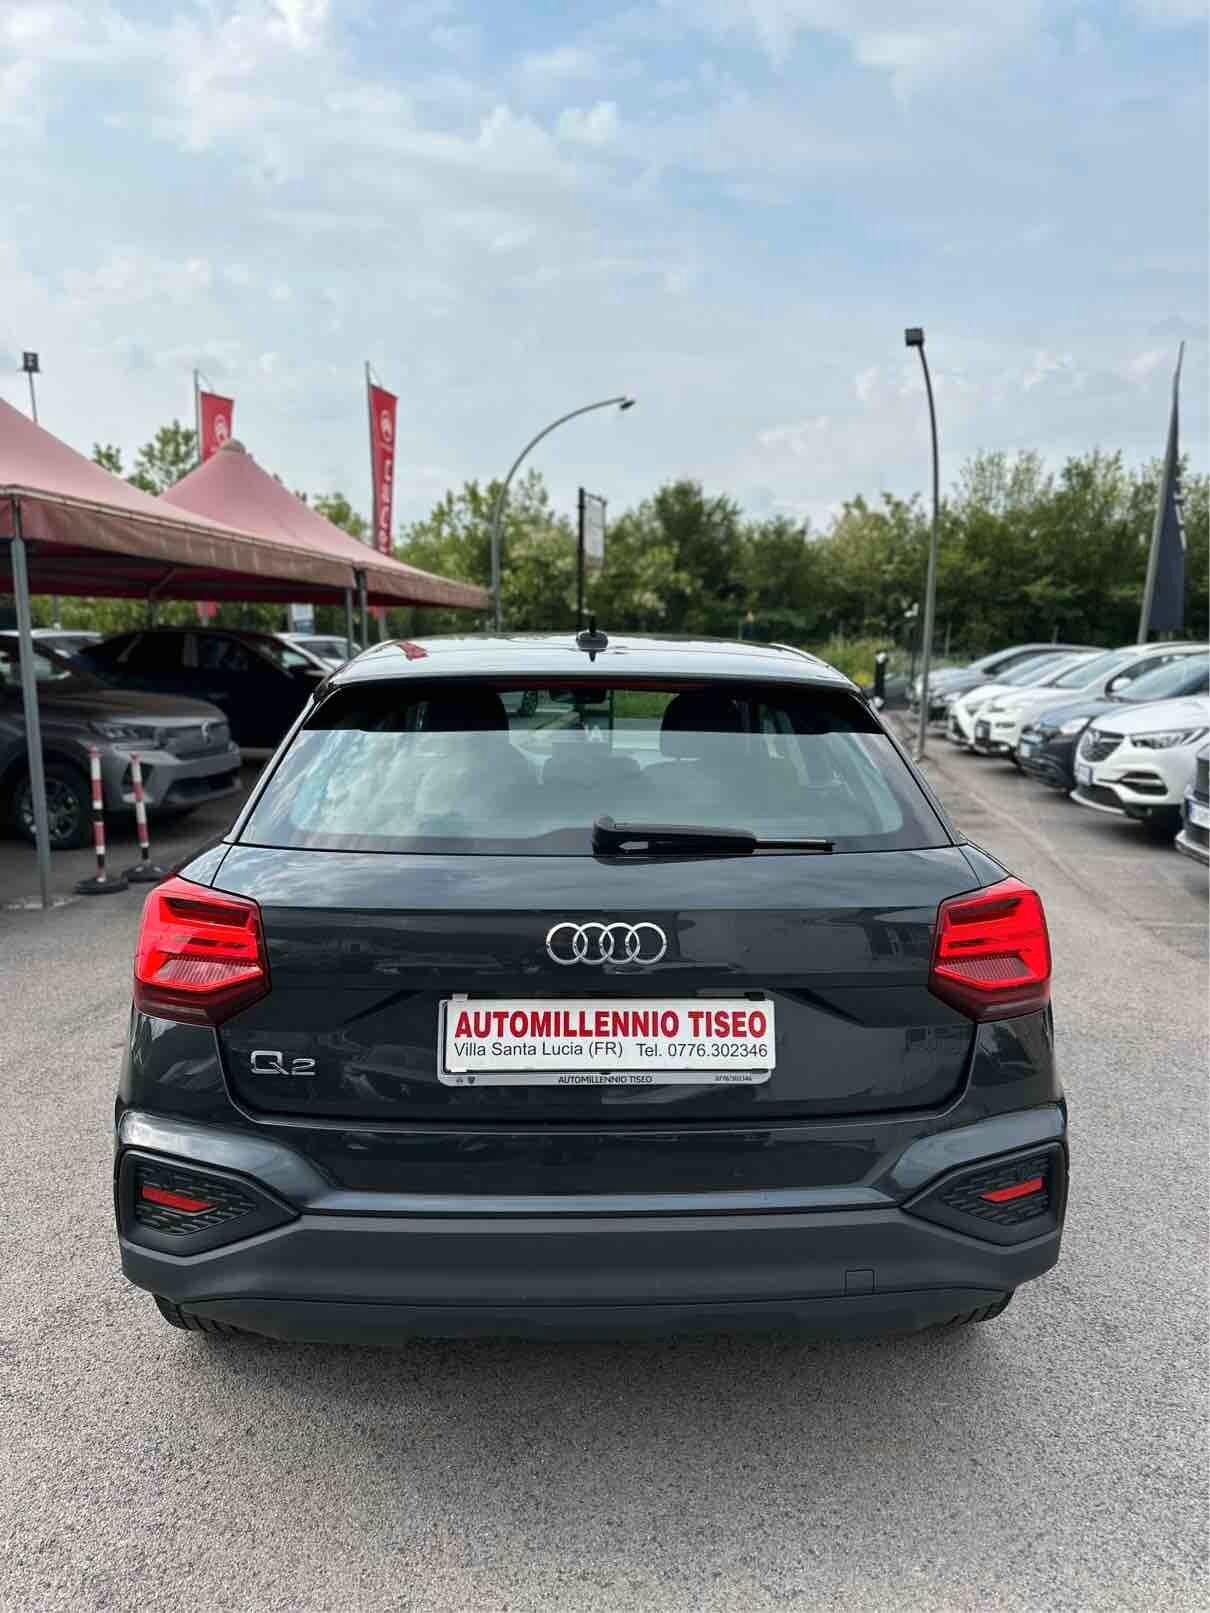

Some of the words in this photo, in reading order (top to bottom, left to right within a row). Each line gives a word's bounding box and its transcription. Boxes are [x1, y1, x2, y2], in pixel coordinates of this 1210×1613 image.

[455, 1010, 680, 1039] AUTOMILLENNIO
[687, 1010, 767, 1039] TISEO
[454, 1041, 486, 1057] Villa
[491, 1041, 536, 1057] Santa
[542, 1041, 583, 1056] Lucia
[589, 1041, 624, 1059] (FR)
[636, 1042, 662, 1057] Tel.
[668, 1043, 768, 1058] 0776.302346
[250, 1050, 316, 1076] Q2
[558, 1075, 627, 1084] AUTOMILLENNIO
[629, 1075, 653, 1084] TISEO
